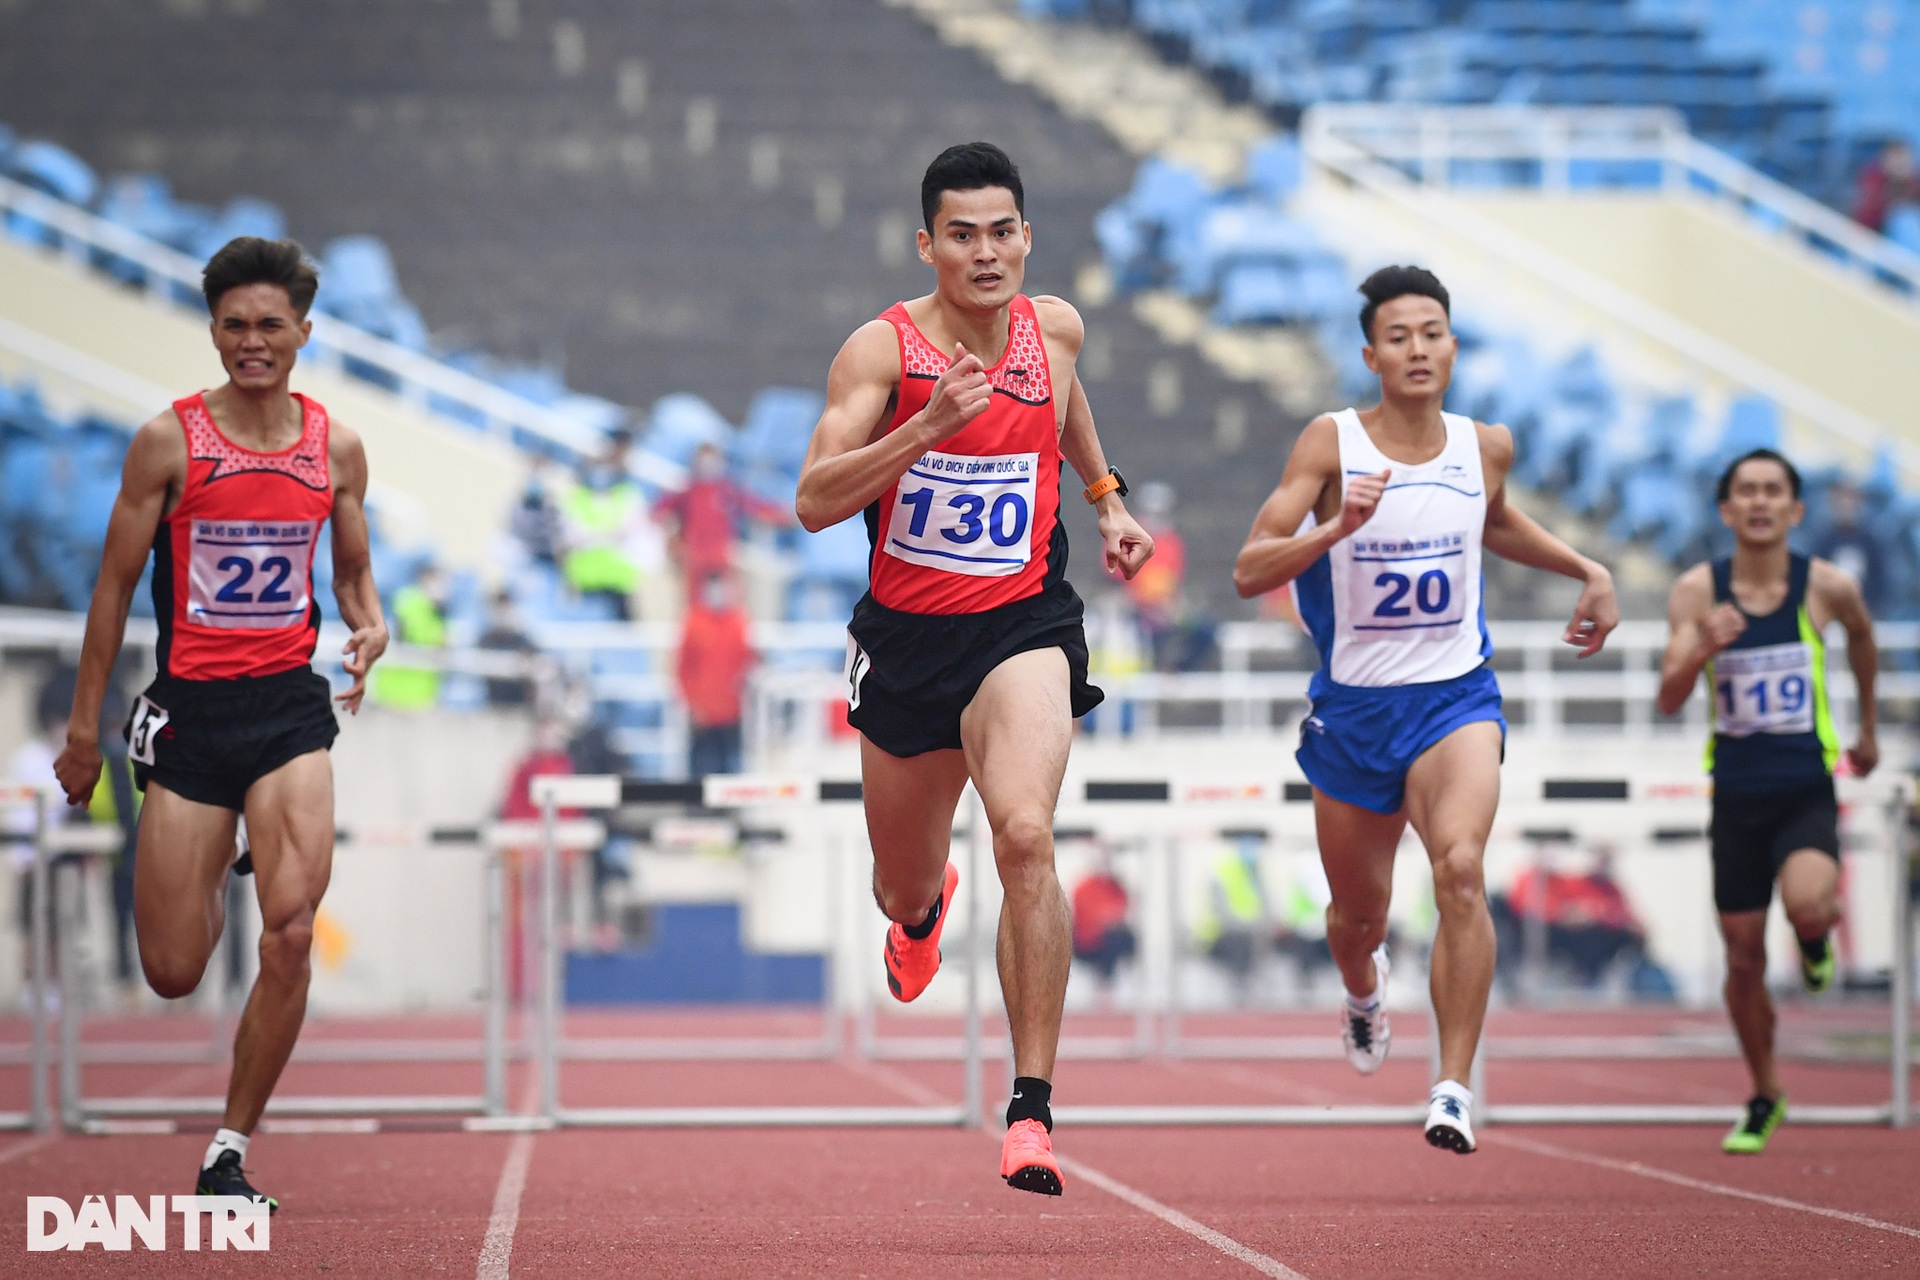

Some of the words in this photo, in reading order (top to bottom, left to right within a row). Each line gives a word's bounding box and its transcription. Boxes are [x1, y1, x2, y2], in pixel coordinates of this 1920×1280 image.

[932, 458, 944, 470] VÔ
[1018, 460, 1029, 472] GIA
[901, 487, 1028, 547] 130
[215, 556, 291, 603] 22
[1373, 569, 1450, 617] 20
[1716, 674, 1805, 716] 119
[135, 705, 160, 757] 5
